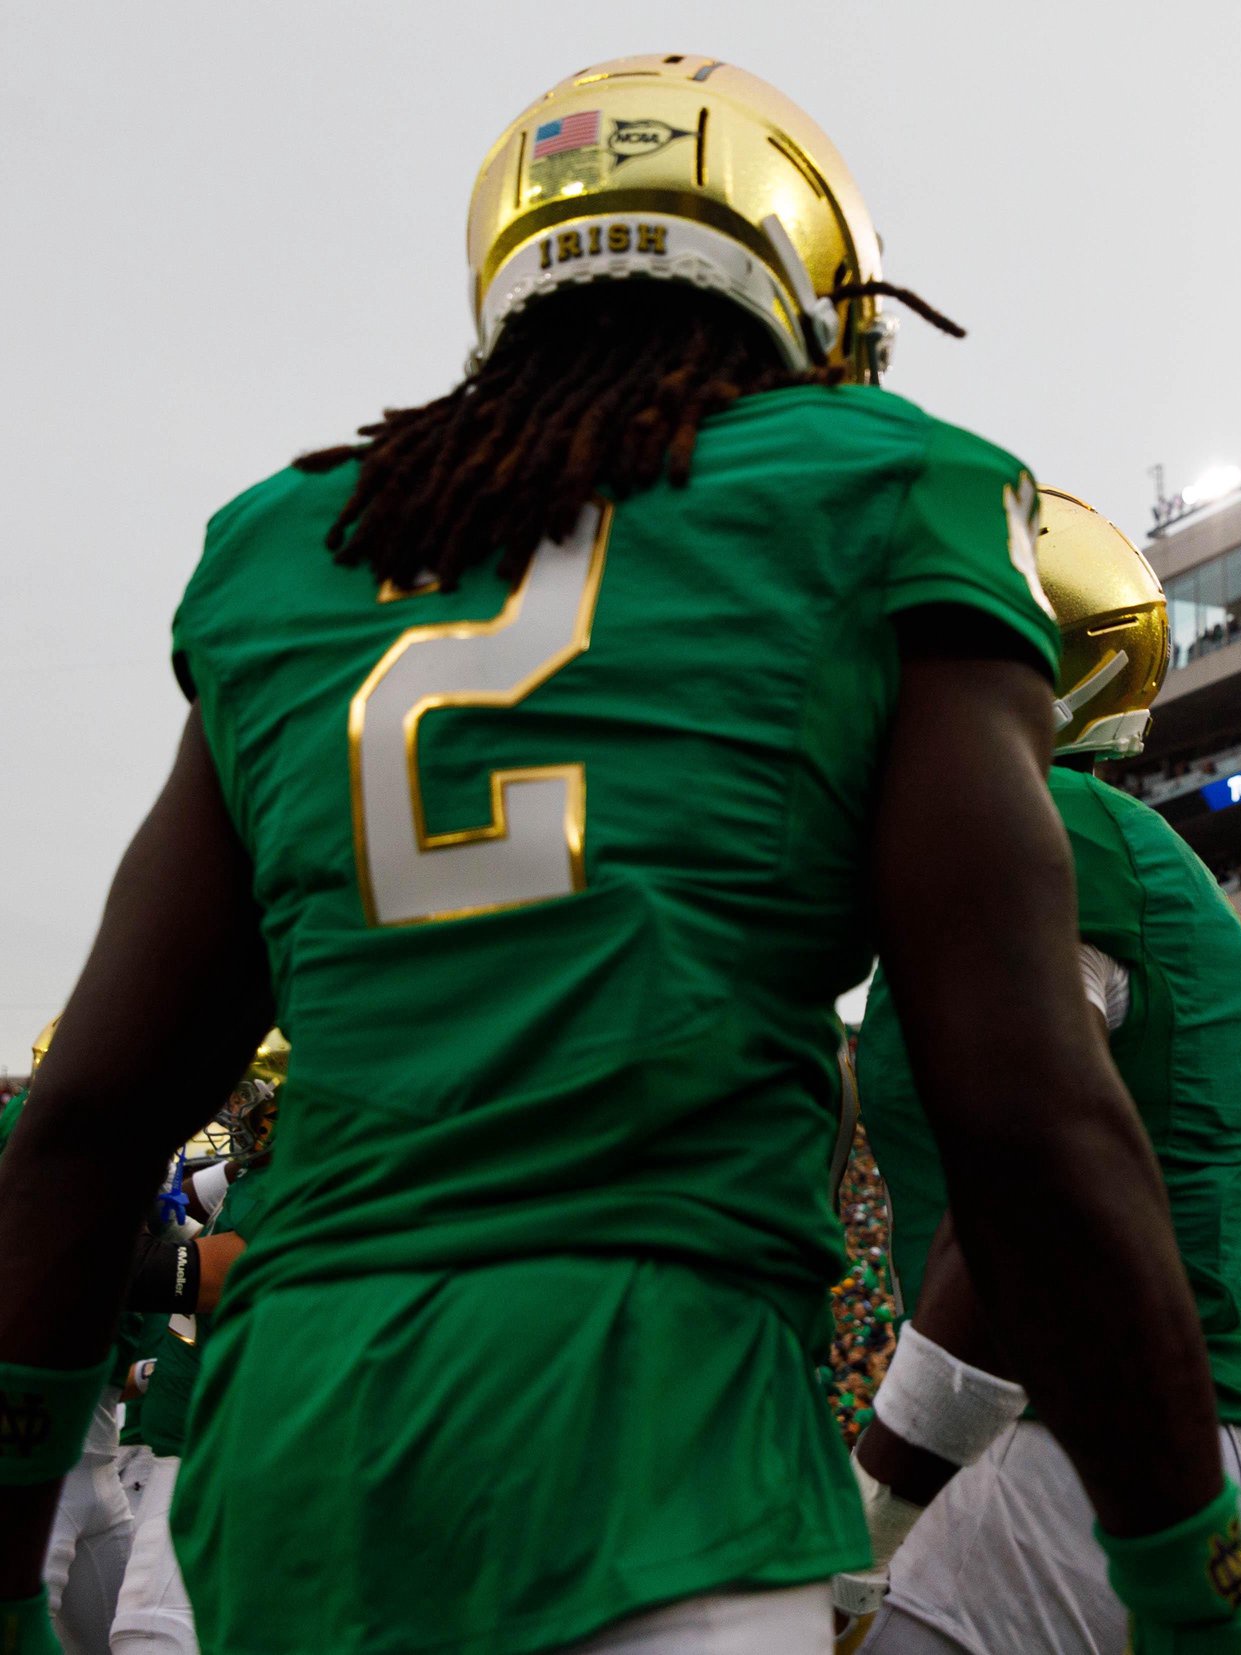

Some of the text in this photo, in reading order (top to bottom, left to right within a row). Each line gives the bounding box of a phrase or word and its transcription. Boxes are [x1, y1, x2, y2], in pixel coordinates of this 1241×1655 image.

[614, 131, 660, 145] NCAA
[539, 222, 668, 271] IRISH
[348, 494, 613, 928] 2
[174, 1248, 188, 1297] Mueller
